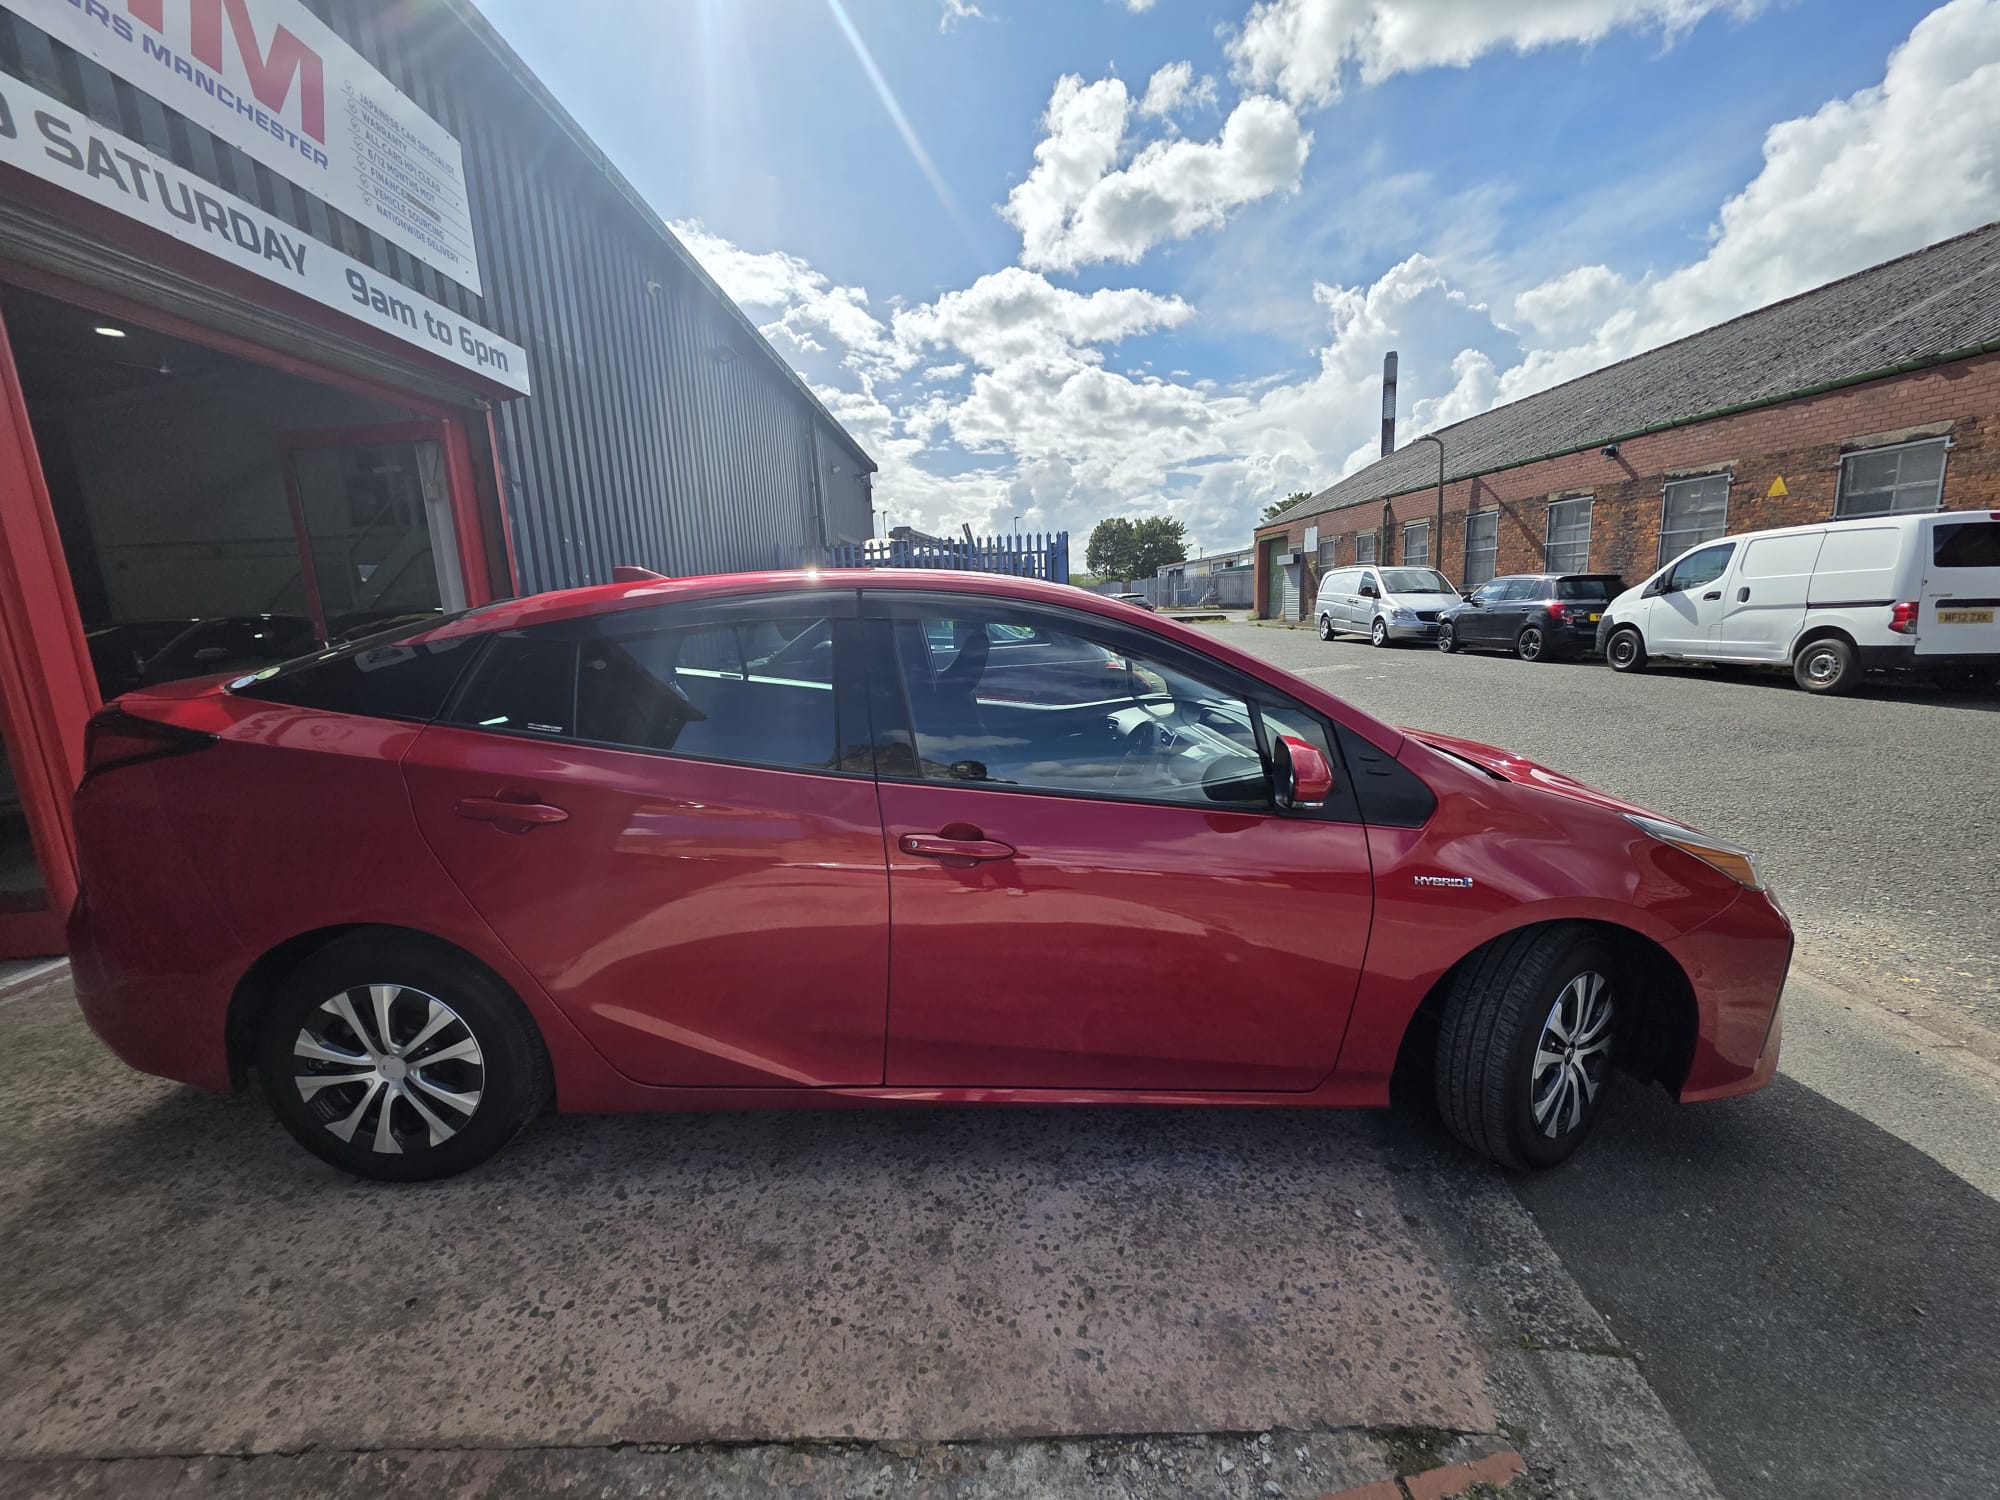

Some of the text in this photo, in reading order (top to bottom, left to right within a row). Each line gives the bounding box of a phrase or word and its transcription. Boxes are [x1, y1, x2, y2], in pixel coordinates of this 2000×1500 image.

[66, 0, 329, 170] RS MANCHESTER
[127, 0, 325, 145] M
[360, 93, 455, 177] JAPANESE CAR SPECIALIST
[361, 110, 407, 152] WARRANTY
[365, 130, 381, 149] ALL
[382, 143, 403, 165] CARS
[418, 170, 441, 193] CLEAR
[367, 148, 436, 204] 6/12 MONTHS MOT
[370, 167, 407, 199] FINANCE
[34, 110, 307, 277] SATURDAY
[345, 268, 418, 330] 9am
[424, 309, 453, 346] to
[458, 326, 509, 373] 6pm
[373, 185, 407, 216] VEHICLE
[408, 208, 445, 241] SOURCING
[376, 203, 426, 244] NATIONWIDE
[427, 237, 459, 264] DELIVERY
[1413, 876, 1464, 888] HYBRID
